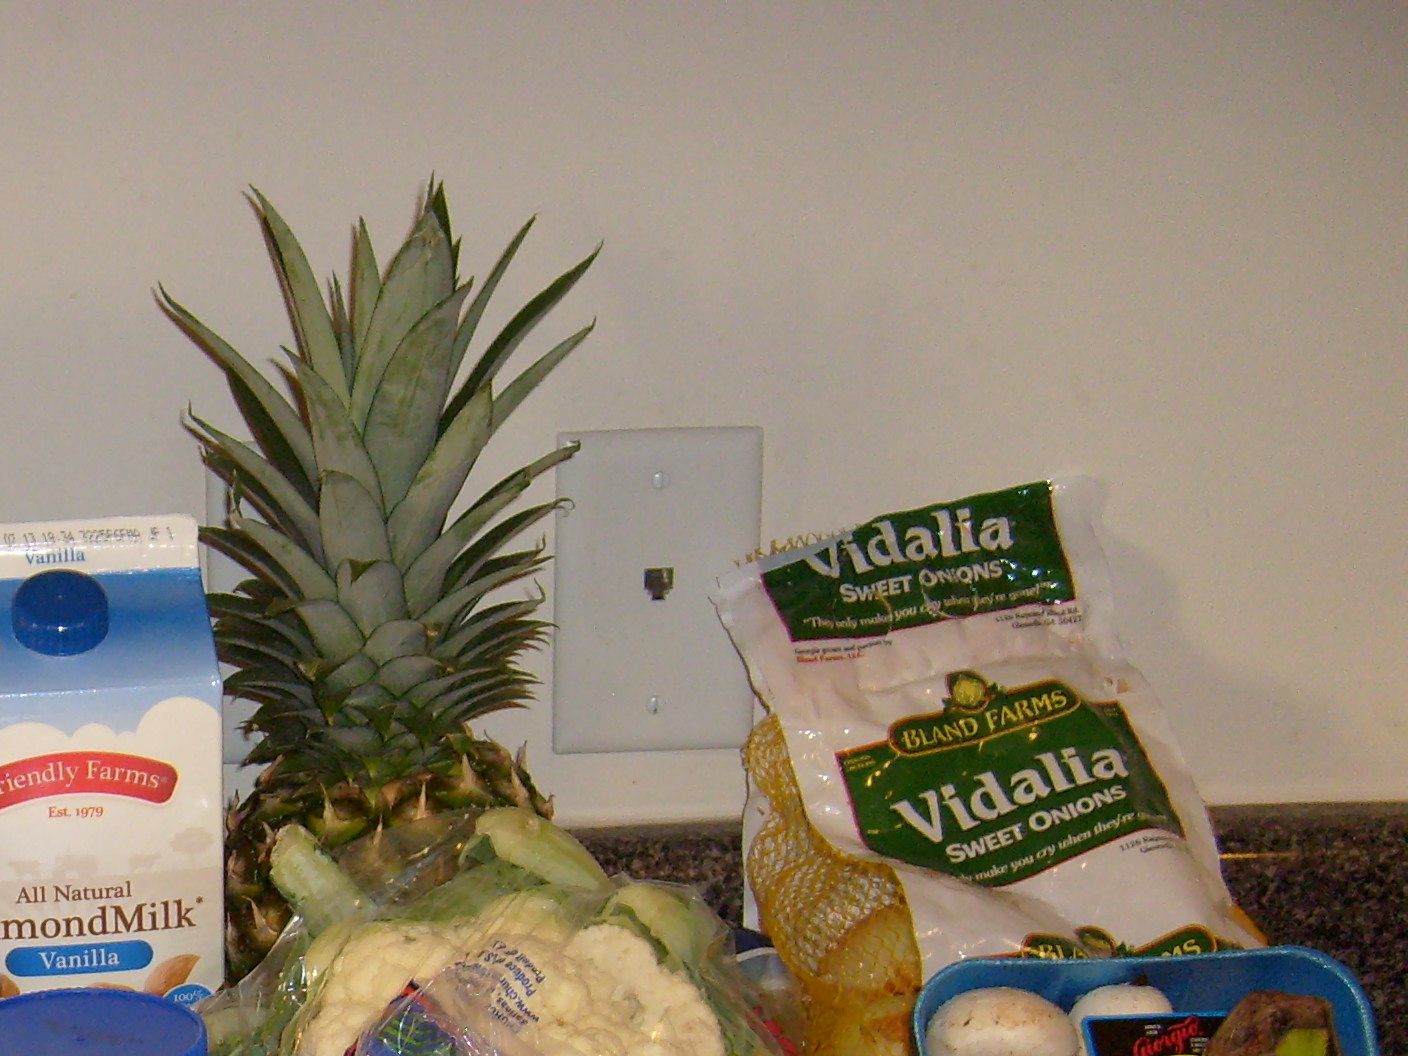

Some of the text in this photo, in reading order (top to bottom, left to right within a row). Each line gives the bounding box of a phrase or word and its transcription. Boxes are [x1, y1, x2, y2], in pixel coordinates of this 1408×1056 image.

[25, 549, 87, 566] Vanilla
[803, 507, 1016, 579] Vidalia
[839, 560, 1004, 603] SWEET ONIONS
[902, 689, 1068, 750] BLAND FARMS
[87, 760, 161, 790] Farms
[890, 746, 1130, 844] Vidalia
[48, 806, 104, 819] Est. 1979
[945, 785, 1127, 864] SWEET ONIONS
[1009, 853, 1034, 874] you
[16, 880, 133, 905] All Natural
[39, 949, 121, 971] Vanilla
